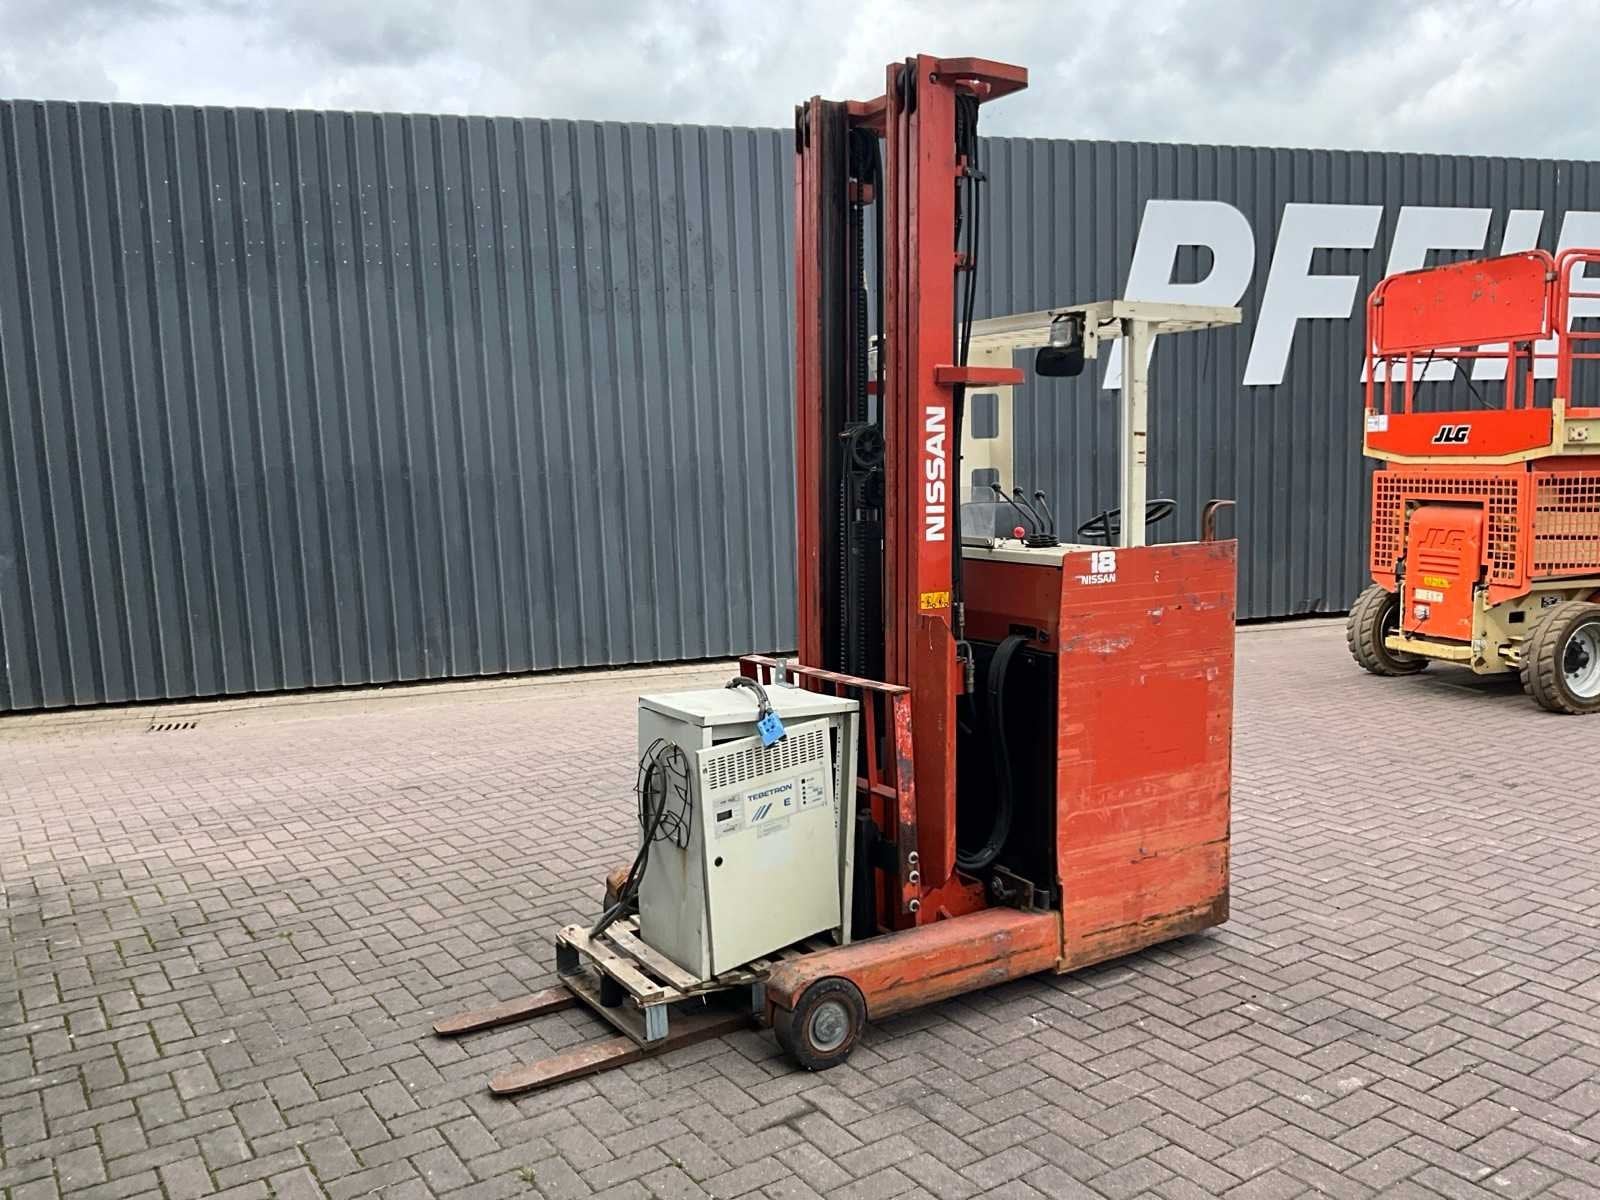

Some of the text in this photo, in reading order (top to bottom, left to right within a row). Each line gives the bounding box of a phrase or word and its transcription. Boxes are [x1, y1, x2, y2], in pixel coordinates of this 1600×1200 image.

[1433, 426, 1469, 443] JLG
[926, 406, 946, 541] NISSAN
[1418, 527, 1465, 548] JLG
[1090, 551, 1117, 573] 18
[1078, 573, 1116, 585] NISSAN
[747, 783, 793, 802] TEBETRON
[783, 797, 792, 806] E
